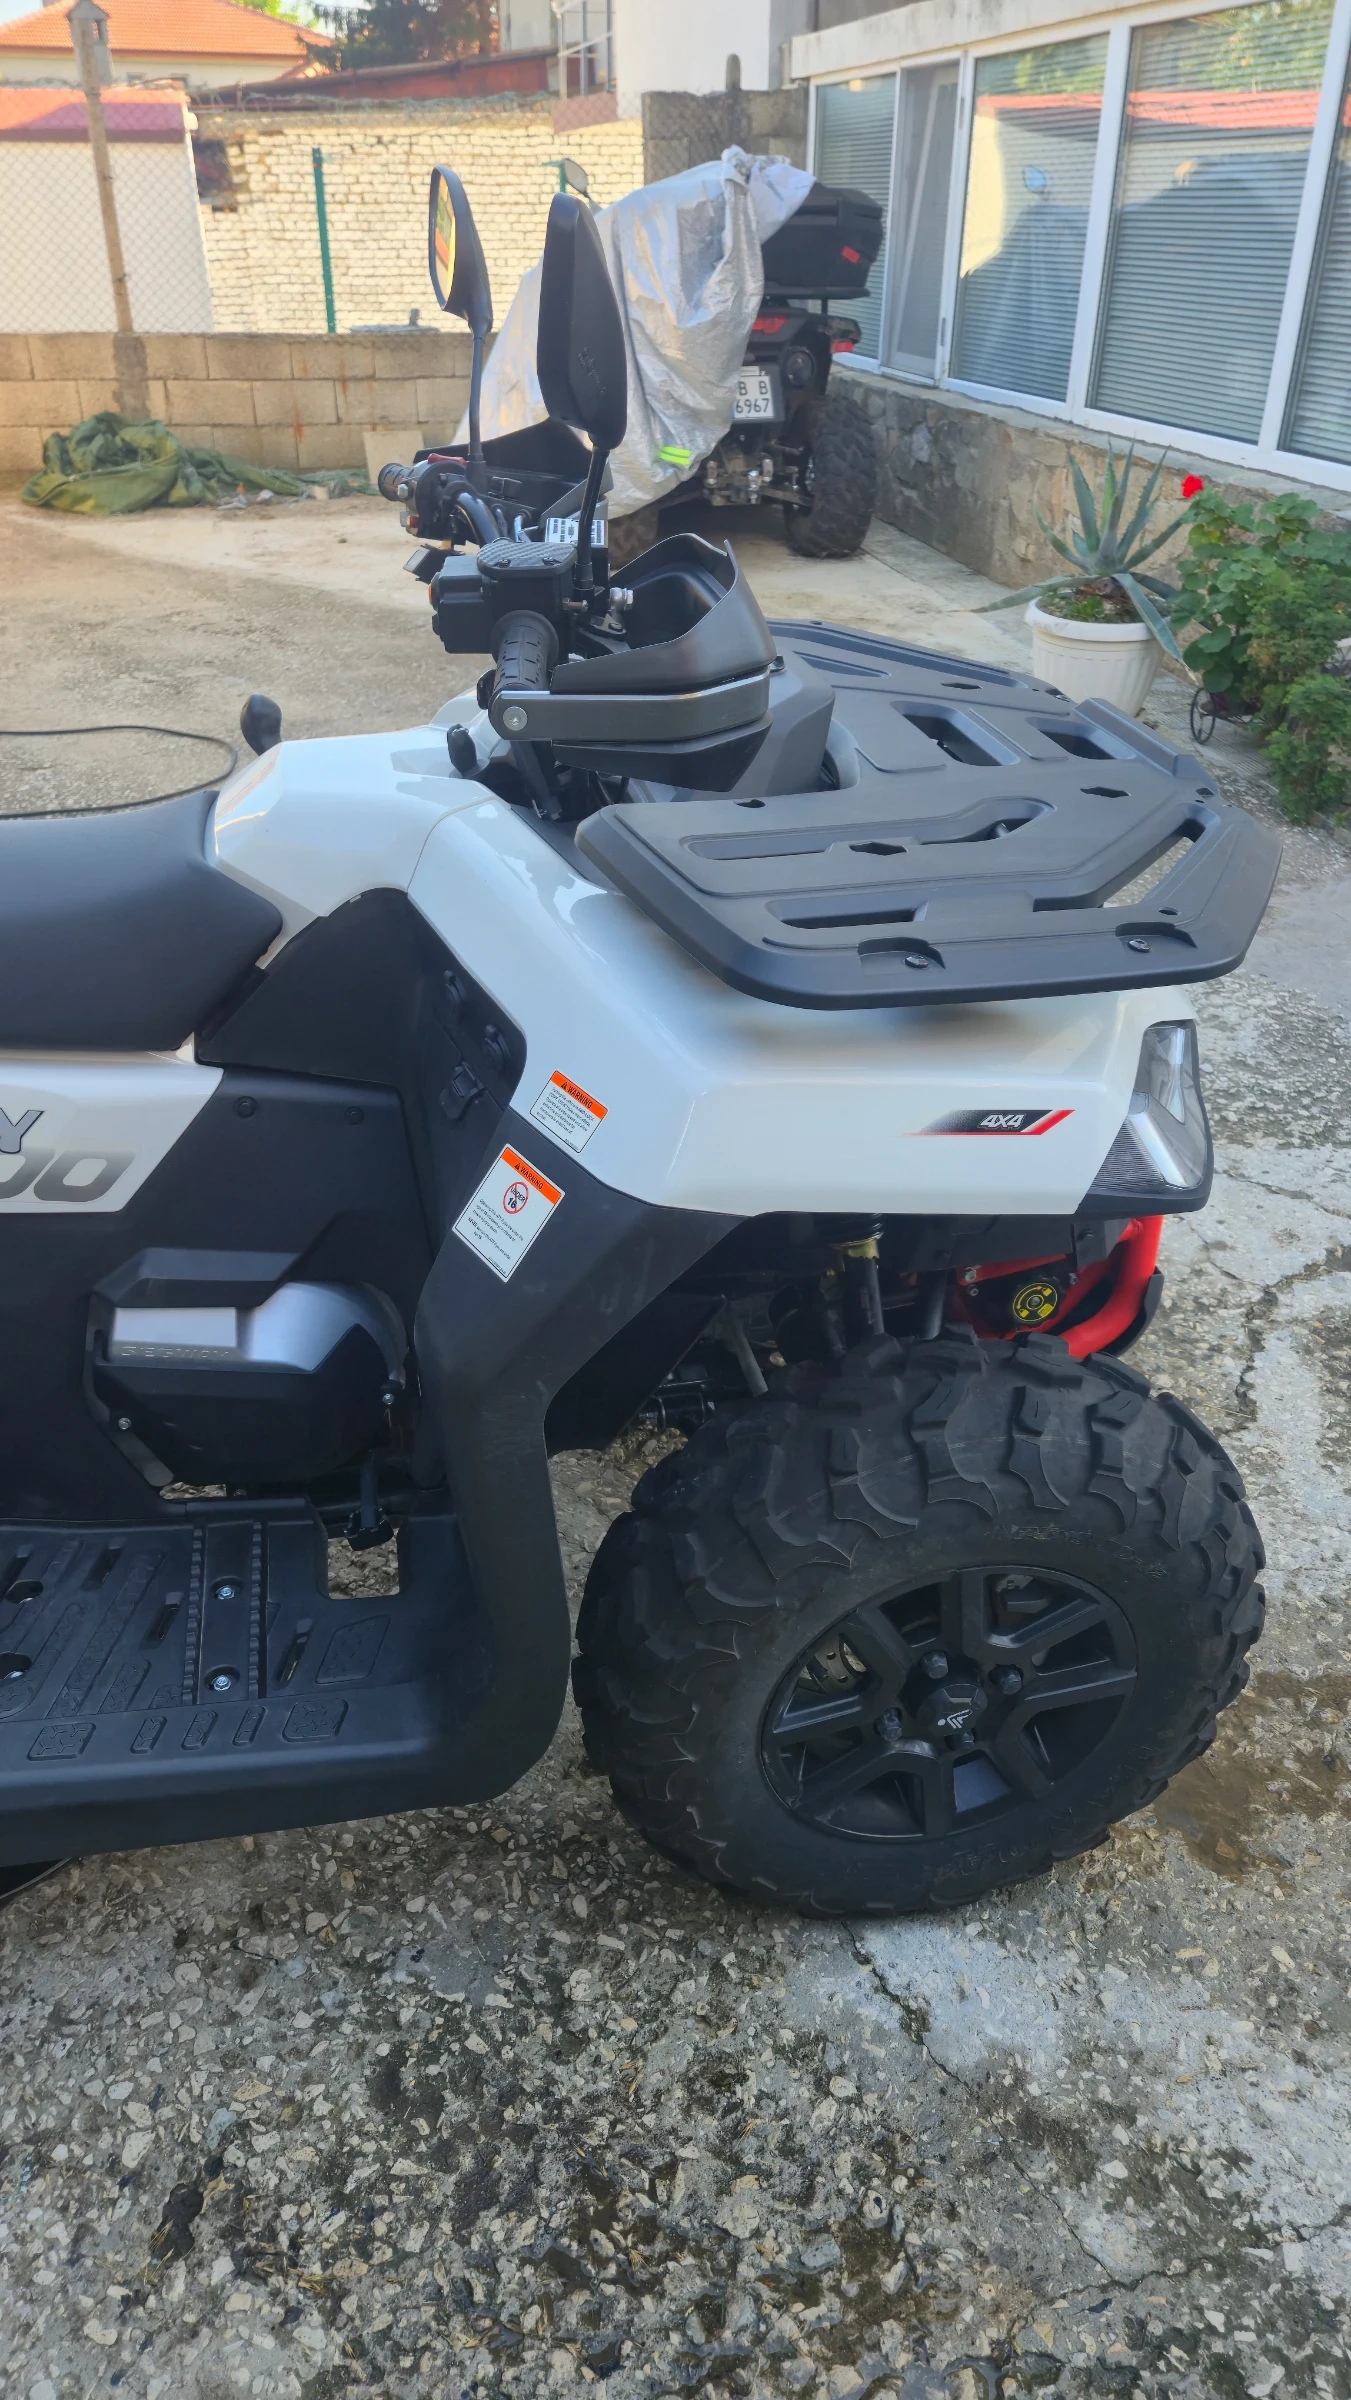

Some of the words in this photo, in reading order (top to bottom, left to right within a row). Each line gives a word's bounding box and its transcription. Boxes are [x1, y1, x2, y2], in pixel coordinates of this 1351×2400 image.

[738, 381, 748, 396] B
[759, 381, 769, 395] B
[735, 398, 770, 414] 6967
[567, 1085, 593, 1109] WARNING
[520, 1167, 544, 1190] WARNING
[507, 1197, 517, 1209] 16
